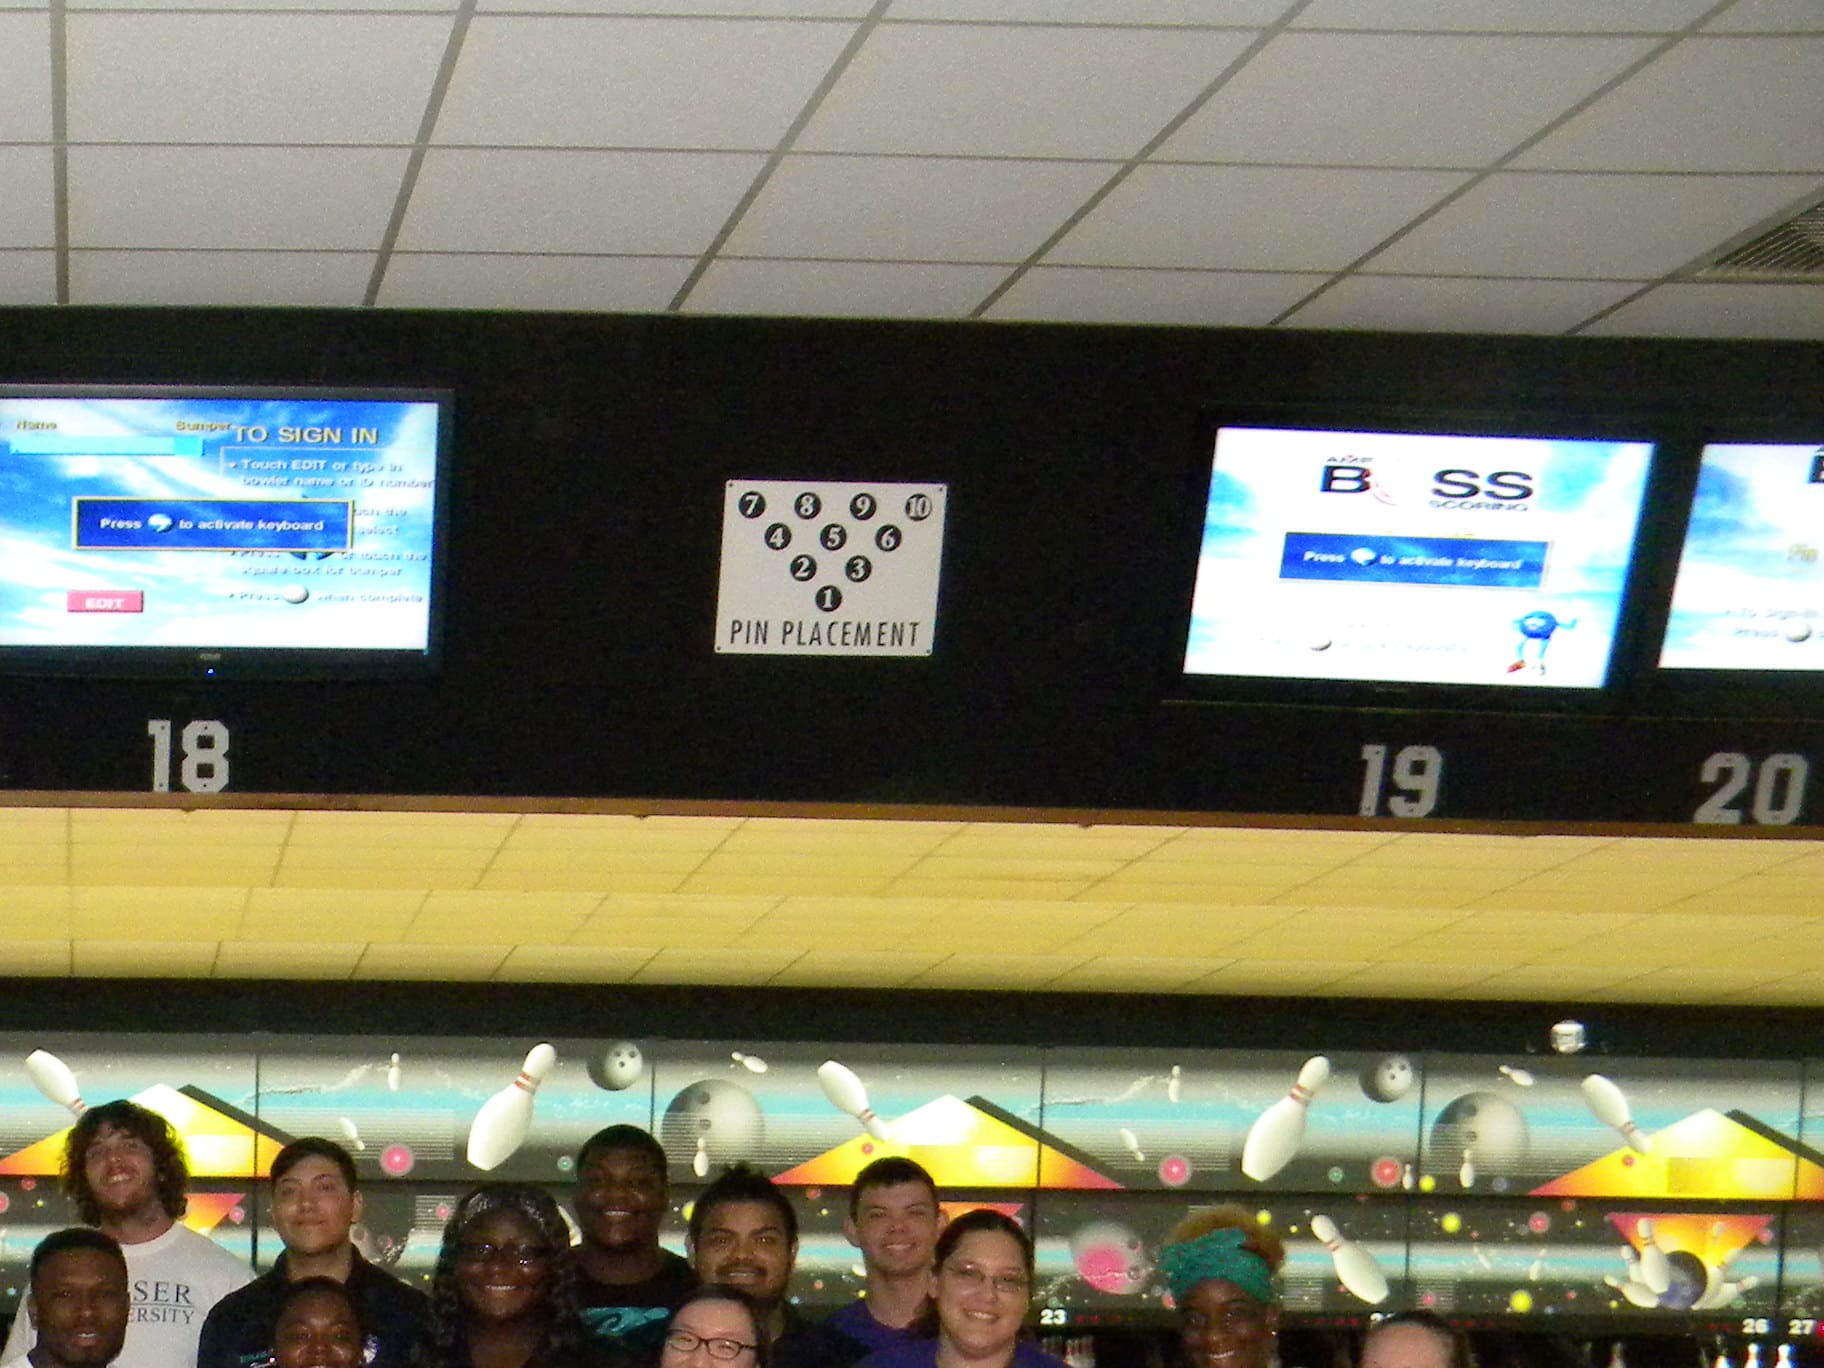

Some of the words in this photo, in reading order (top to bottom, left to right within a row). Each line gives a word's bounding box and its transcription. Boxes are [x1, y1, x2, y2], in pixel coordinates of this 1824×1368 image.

[176, 420, 234, 432] Bumper
[234, 426, 270, 442] TO
[278, 426, 343, 444] SIGN
[351, 427, 379, 445] IN
[240, 459, 288, 471] Touch
[291, 459, 328, 471] EDIT
[745, 494, 759, 515] 7
[800, 495, 815, 517] 8
[856, 495, 871, 517] 9
[909, 496, 927, 517] 10
[1428, 499, 1529, 512] SCORING
[99, 517, 143, 531] Press
[178, 519, 194, 530] to
[197, 519, 254, 531] activate
[257, 519, 326, 533] keyboard
[768, 527, 785, 548] 4
[826, 526, 842, 548] 5
[882, 527, 896, 549] 6
[794, 557, 810, 578] 2
[851, 557, 866, 579] 3
[1303, 551, 1345, 564] Press
[1379, 554, 1395, 566] to
[1398, 555, 1454, 568] activate
[1455, 557, 1522, 571] keyboard
[85, 598, 125, 610] EDIT
[823, 588, 834, 609] 1
[730, 619, 769, 645] PIN
[781, 621, 921, 647] PLACEMENT
[147, 719, 230, 793] 18
[1358, 744, 1444, 819] 19
[1693, 752, 1809, 826] 20
[1040, 1308, 1067, 1325] 23
[1742, 1318, 1770, 1335] 26
[1788, 1318, 1815, 1335] 27
